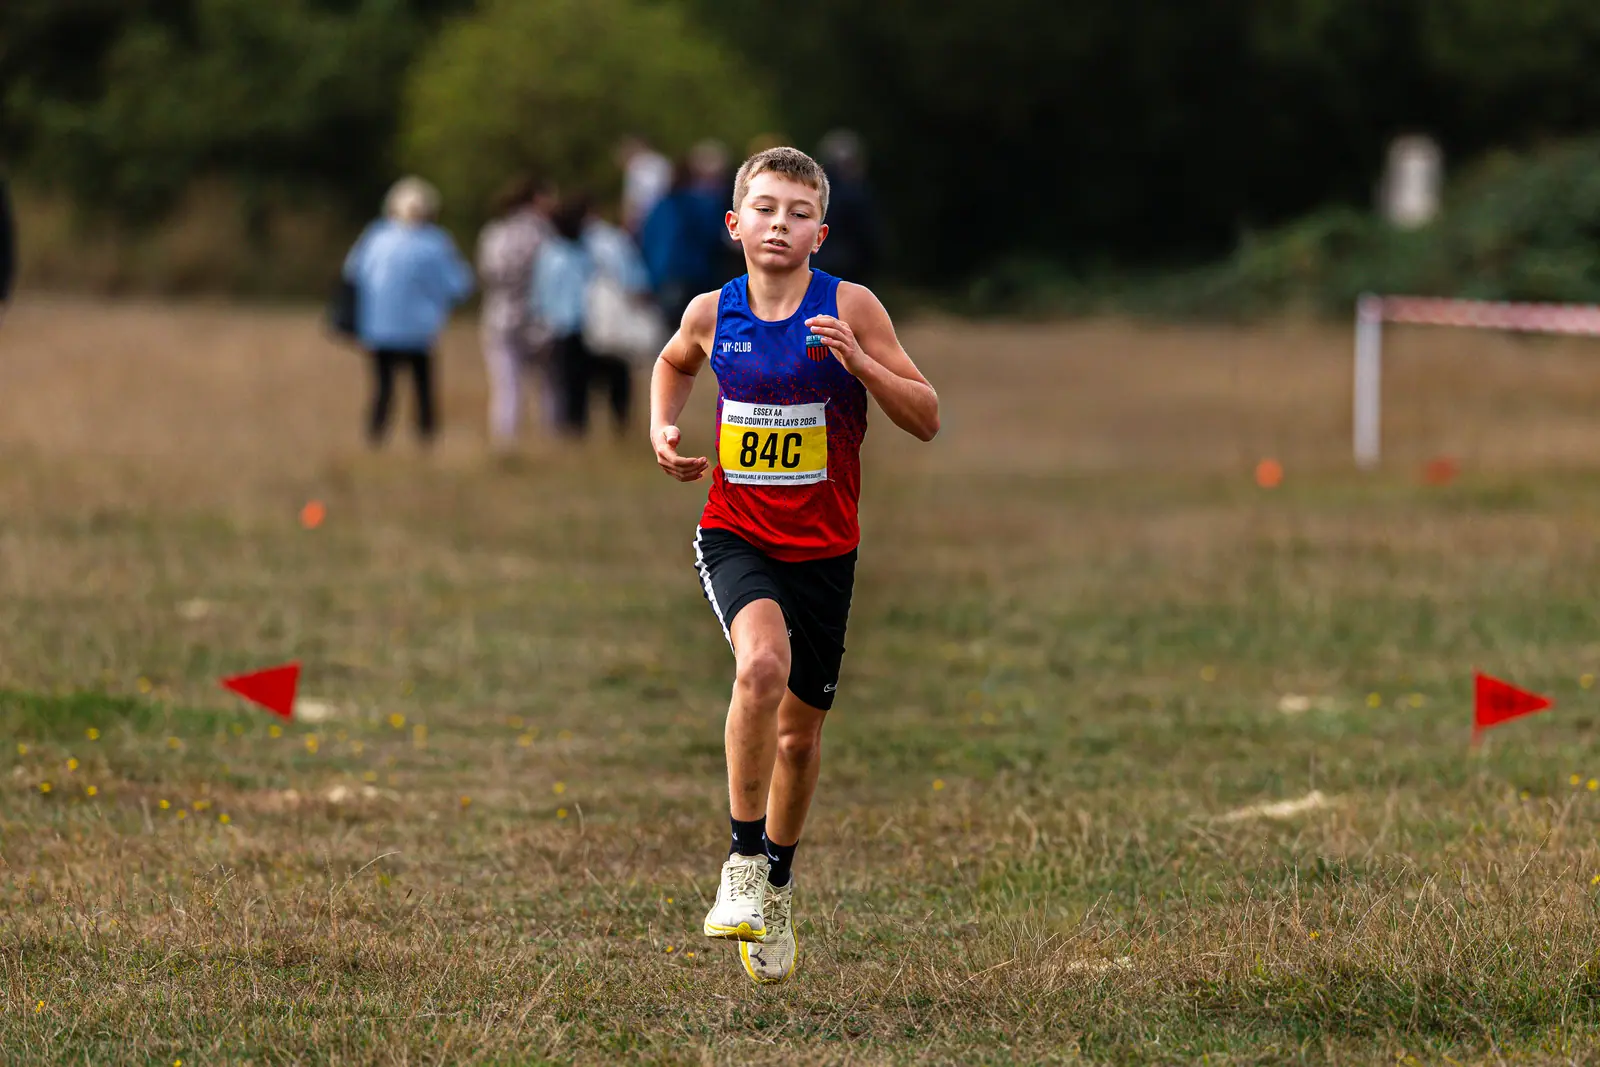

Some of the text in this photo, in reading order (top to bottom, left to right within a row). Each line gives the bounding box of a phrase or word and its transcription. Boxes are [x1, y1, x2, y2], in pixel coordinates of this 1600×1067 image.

[753, 408, 782, 416] ESSEX AA
[728, 414, 817, 427] CROSS COUNTRY RELAYS 2026
[740, 431, 803, 468] 84C
